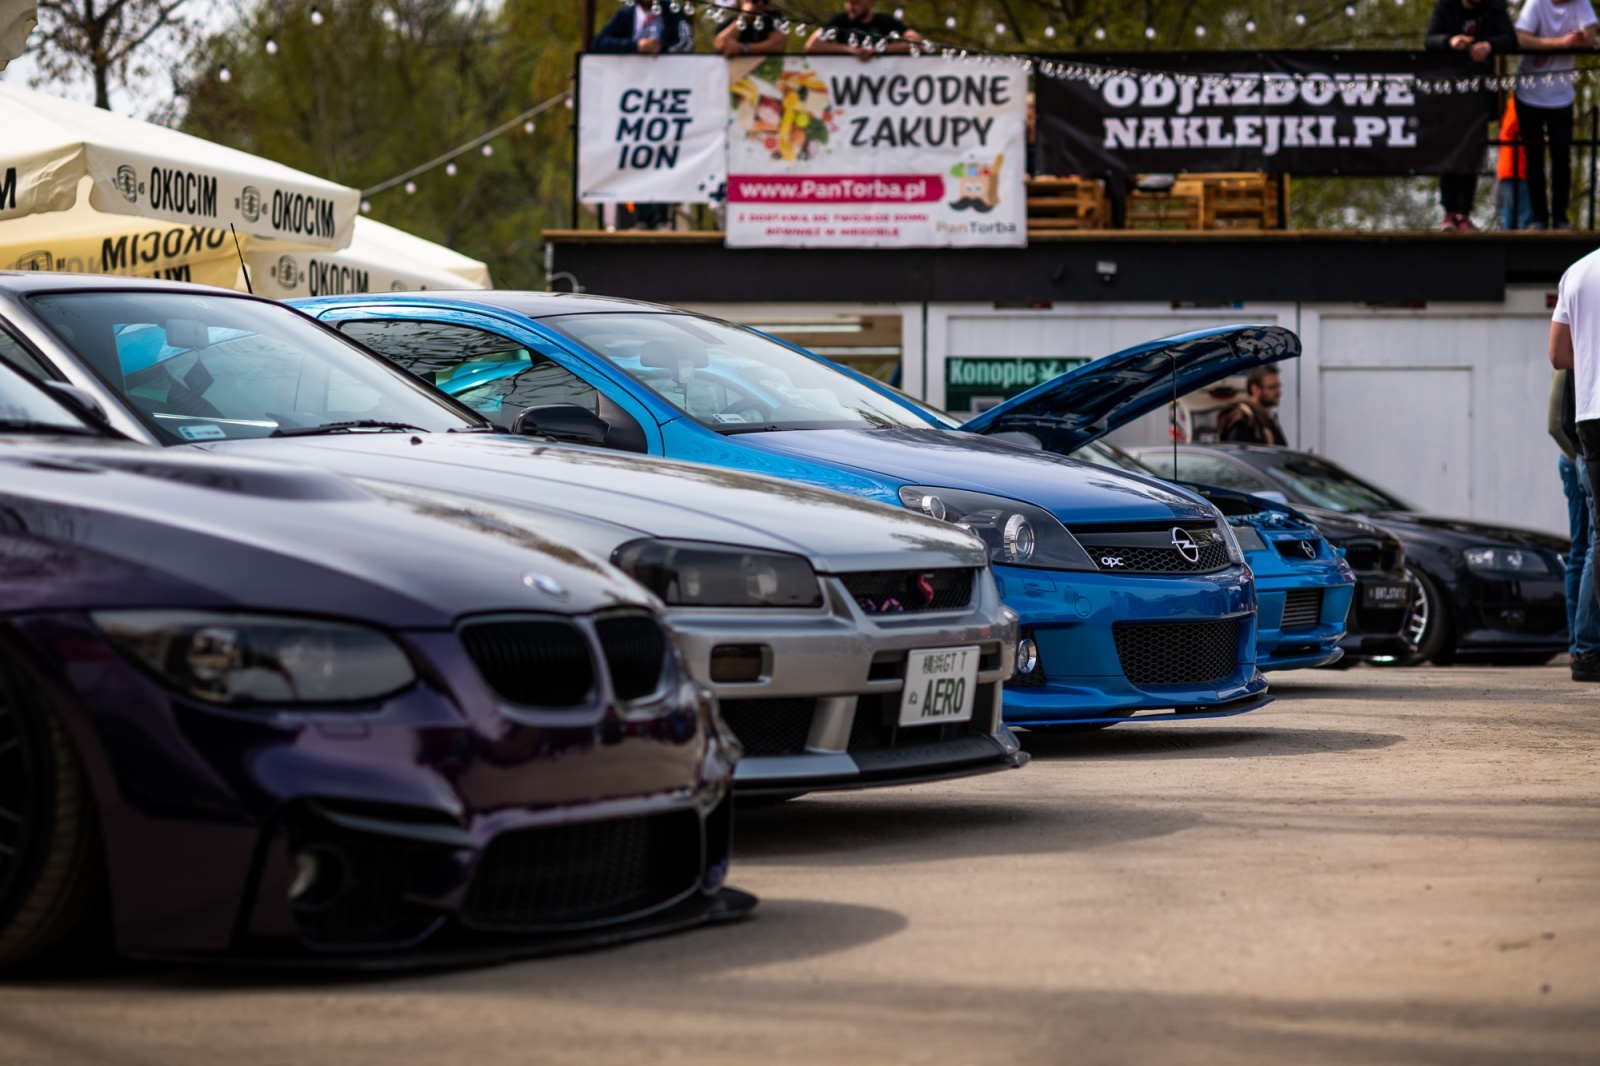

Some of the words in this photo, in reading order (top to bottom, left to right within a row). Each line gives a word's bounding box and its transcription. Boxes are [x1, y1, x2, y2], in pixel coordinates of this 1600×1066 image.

[619, 88, 692, 114] CHE
[831, 74, 1010, 106] WYGODNE
[1102, 72, 1415, 115] ODJAZDOWE
[616, 117, 693, 142] MOT
[851, 115, 994, 147] ZAKUPY
[1103, 116, 1417, 155] NAKLEJKI.PL
[618, 144, 679, 170] ION
[150, 166, 217, 218] OKOCIM
[739, 180, 926, 201] www.PanTorba.pl
[271, 189, 335, 239] OKOCIM
[935, 221, 1017, 234] PanTorba
[308, 259, 369, 297] OKOCIM
[951, 358, 1037, 389] Konopie
[921, 677, 966, 717] AERO
